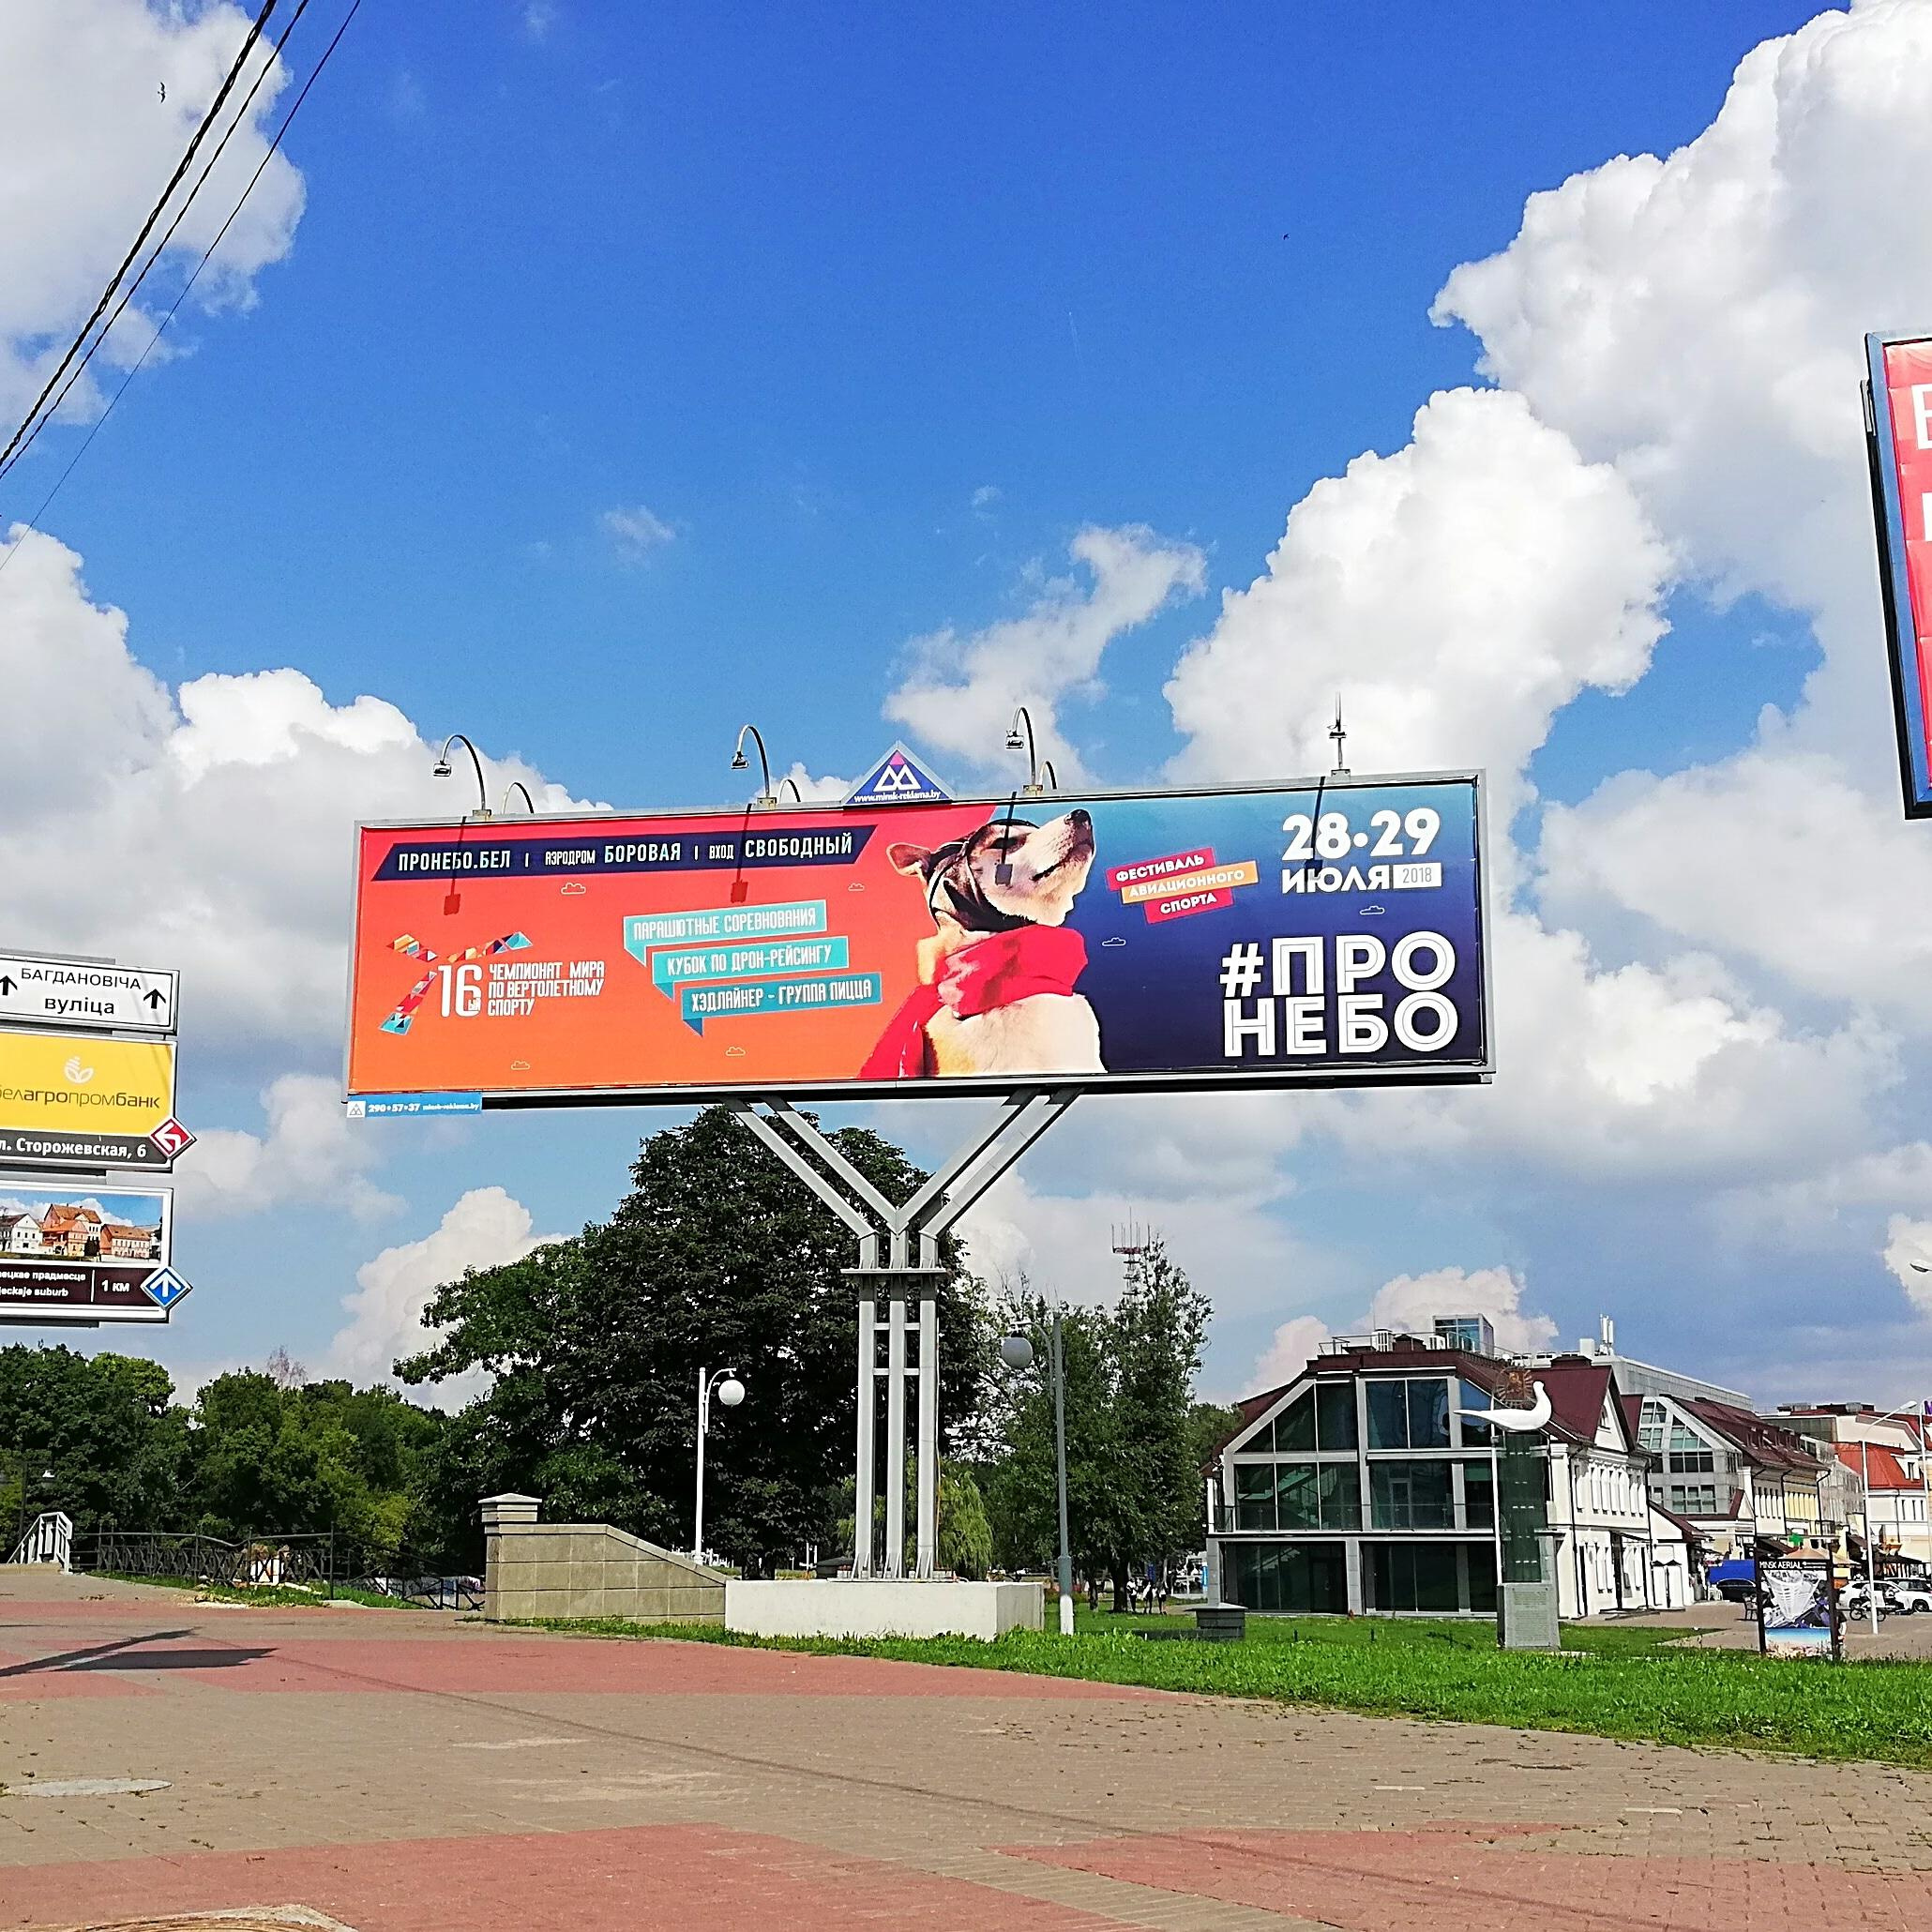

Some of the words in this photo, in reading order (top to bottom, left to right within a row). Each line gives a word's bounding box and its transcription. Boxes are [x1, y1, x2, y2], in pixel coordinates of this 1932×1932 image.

[398, 851, 511, 871] ПРОНЕБО.БЕЛ
[545, 850, 596, 867] АЭРОДРОМ
[604, 842, 681, 864] БОРОВАЯ
[709, 844, 734, 861] ВХОД
[745, 832, 853, 859] СВОБОДНЫЙ
[1115, 854, 1205, 883] ФЕСТИВАЛЬ
[1281, 864, 1390, 894] ИЮЛЯ
[1402, 867, 1432, 883] 2018
[1128, 869, 1245, 898] АВИАЦИОННОГО
[1160, 892, 1217, 914] СПОРТА
[633, 915, 720, 941] ПАРАШЮТНЫЕ
[723, 907, 816, 933] СОРЕВНОВАНИЯ
[489, 962, 563, 980] ЧЕМПИОНАТ
[569, 960, 605, 978] МИРА
[667, 957, 707, 976] КУБОК
[711, 955, 727, 972] ПО
[731, 943, 832, 974] ДРОН-РЕЙСИНГУ
[1219, 930, 1456, 997] #ПРО
[21, 968, 142, 989] БАГДАНОВІЧА
[488, 981, 506, 999] ПО
[506, 978, 605, 998] ВЕРТОЛЕТНОМУ
[437, 963, 483, 1018] 16
[691, 988, 763, 1013] ХЭДЛАЙНЕР
[778, 985, 826, 1005] ГРУППА
[830, 979, 872, 1001] ПИЦЦА
[44, 997, 114, 1016] вуліца
[487, 999, 536, 1017] СПОРТУ
[1223, 990, 1458, 1057] НЕБО
[0, 1084, 160, 1109] елагропромбанк
[16, 1137, 132, 1159] Сторожевская,
[136, 1144, 147, 1157] 6
[0, 1271, 30, 1280] ецкае
[101, 1280, 109, 1292] 1
[112, 1281, 130, 1292] км
[34, 1287, 69, 1297] suburb
[1777, 1561, 1803, 1569] AERIAL
